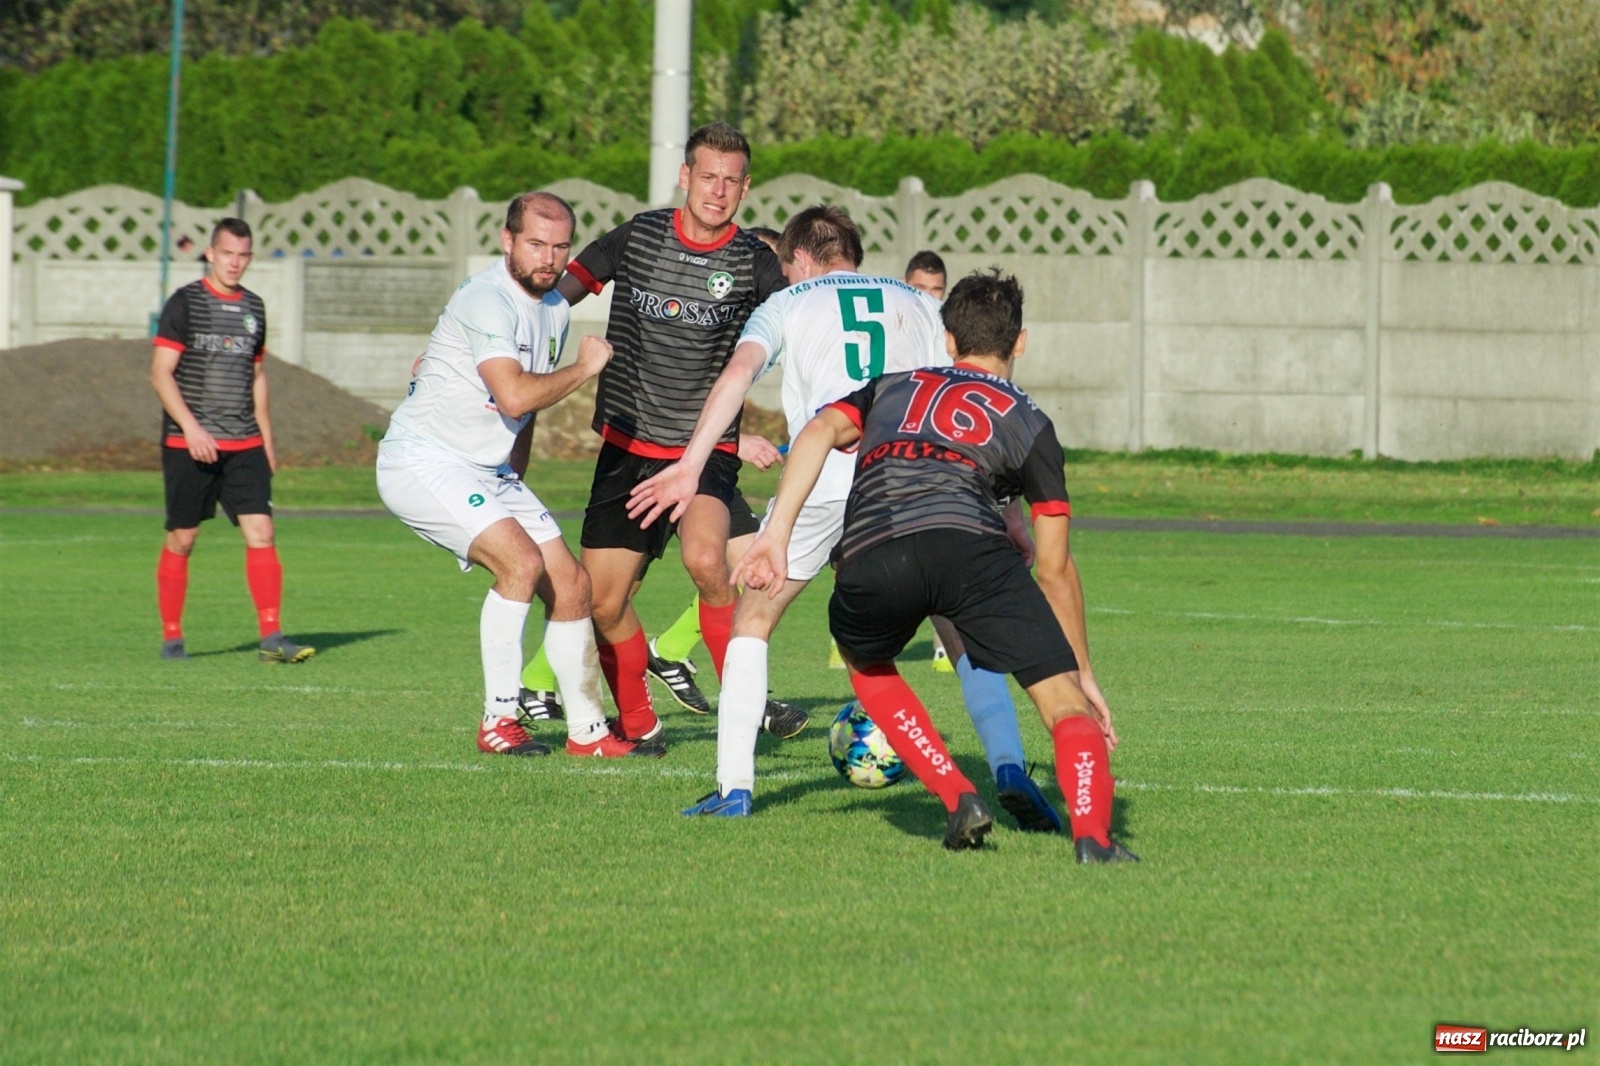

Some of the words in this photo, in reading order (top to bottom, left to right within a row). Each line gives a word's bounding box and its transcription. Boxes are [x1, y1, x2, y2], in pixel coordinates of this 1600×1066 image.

[814, 277, 870, 288] POLONIA
[630, 287, 741, 326] PROSAT
[837, 288, 886, 381] 5
[897, 371, 1018, 446] 16
[468, 493, 486, 508] 9
